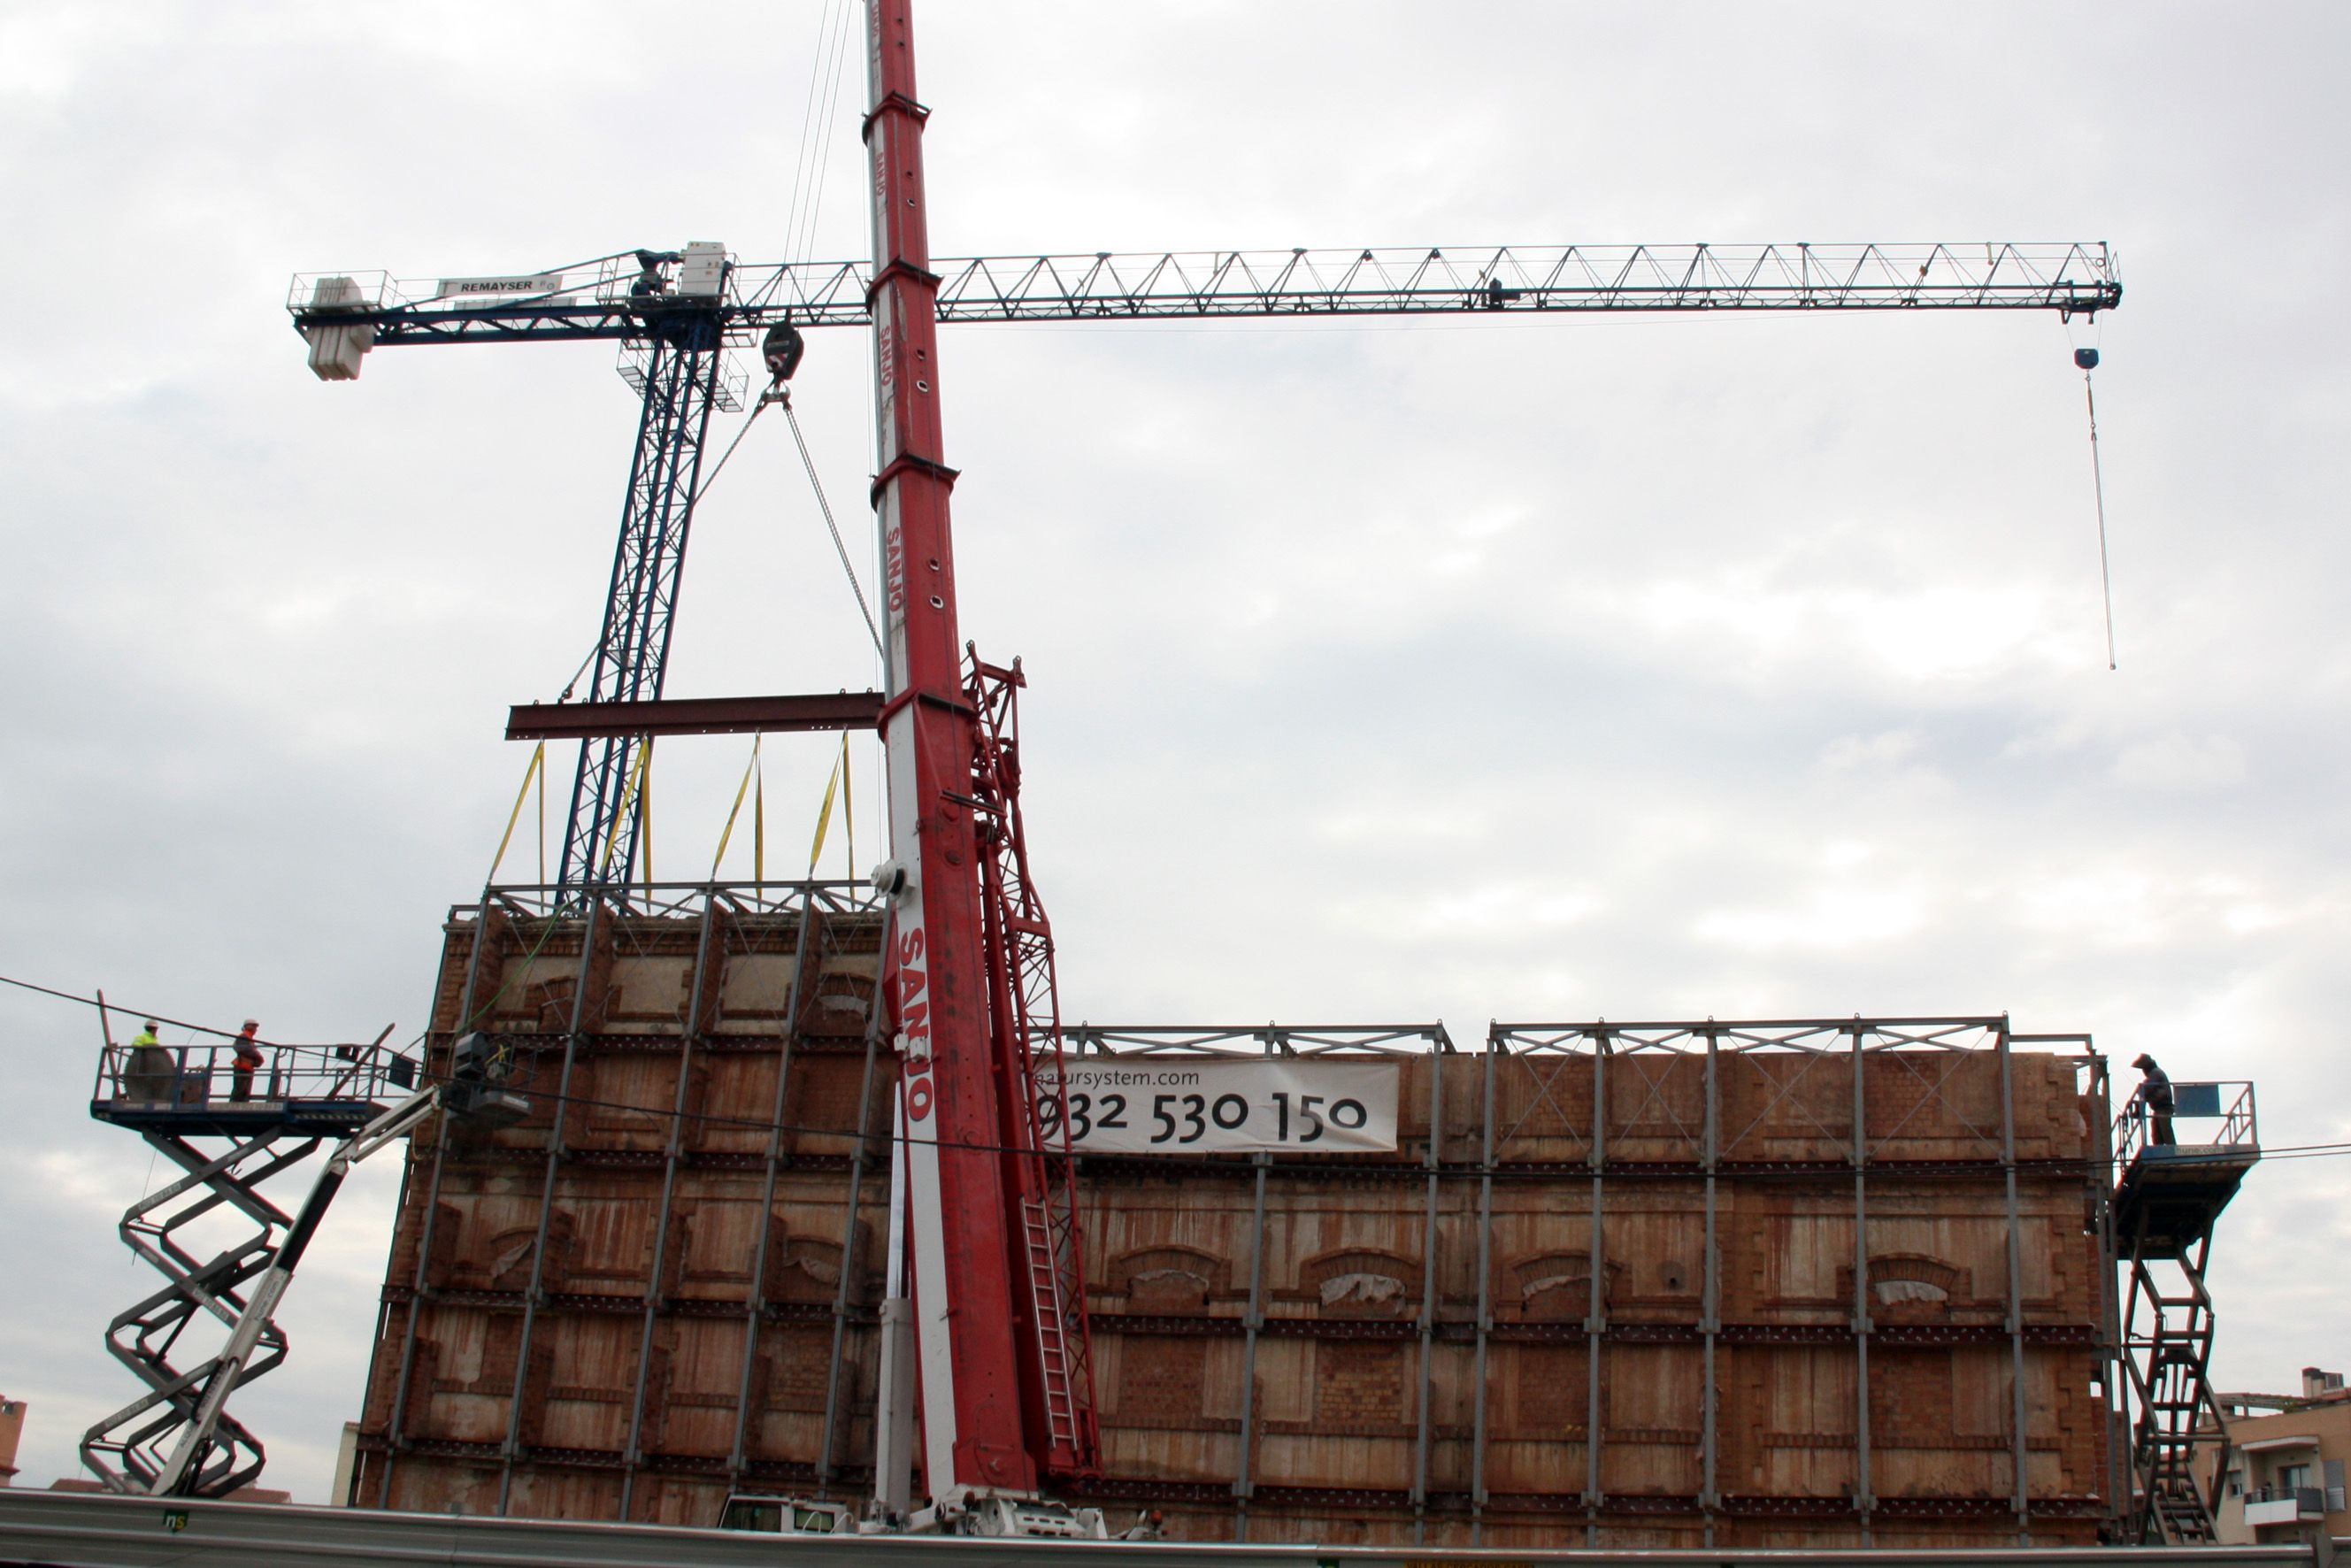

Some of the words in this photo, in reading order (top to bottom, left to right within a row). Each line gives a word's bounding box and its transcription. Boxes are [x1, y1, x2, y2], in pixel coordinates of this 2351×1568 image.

[461, 280, 533, 293] REMAYSER
[880, 325, 894, 387] SANJO
[887, 527, 903, 612] SANJO
[1036, 1093, 1128, 1142] 932
[1150, 1094, 1249, 1144] 530
[1272, 1092, 1368, 1143] 150
[165, 1514, 186, 1531] ns
